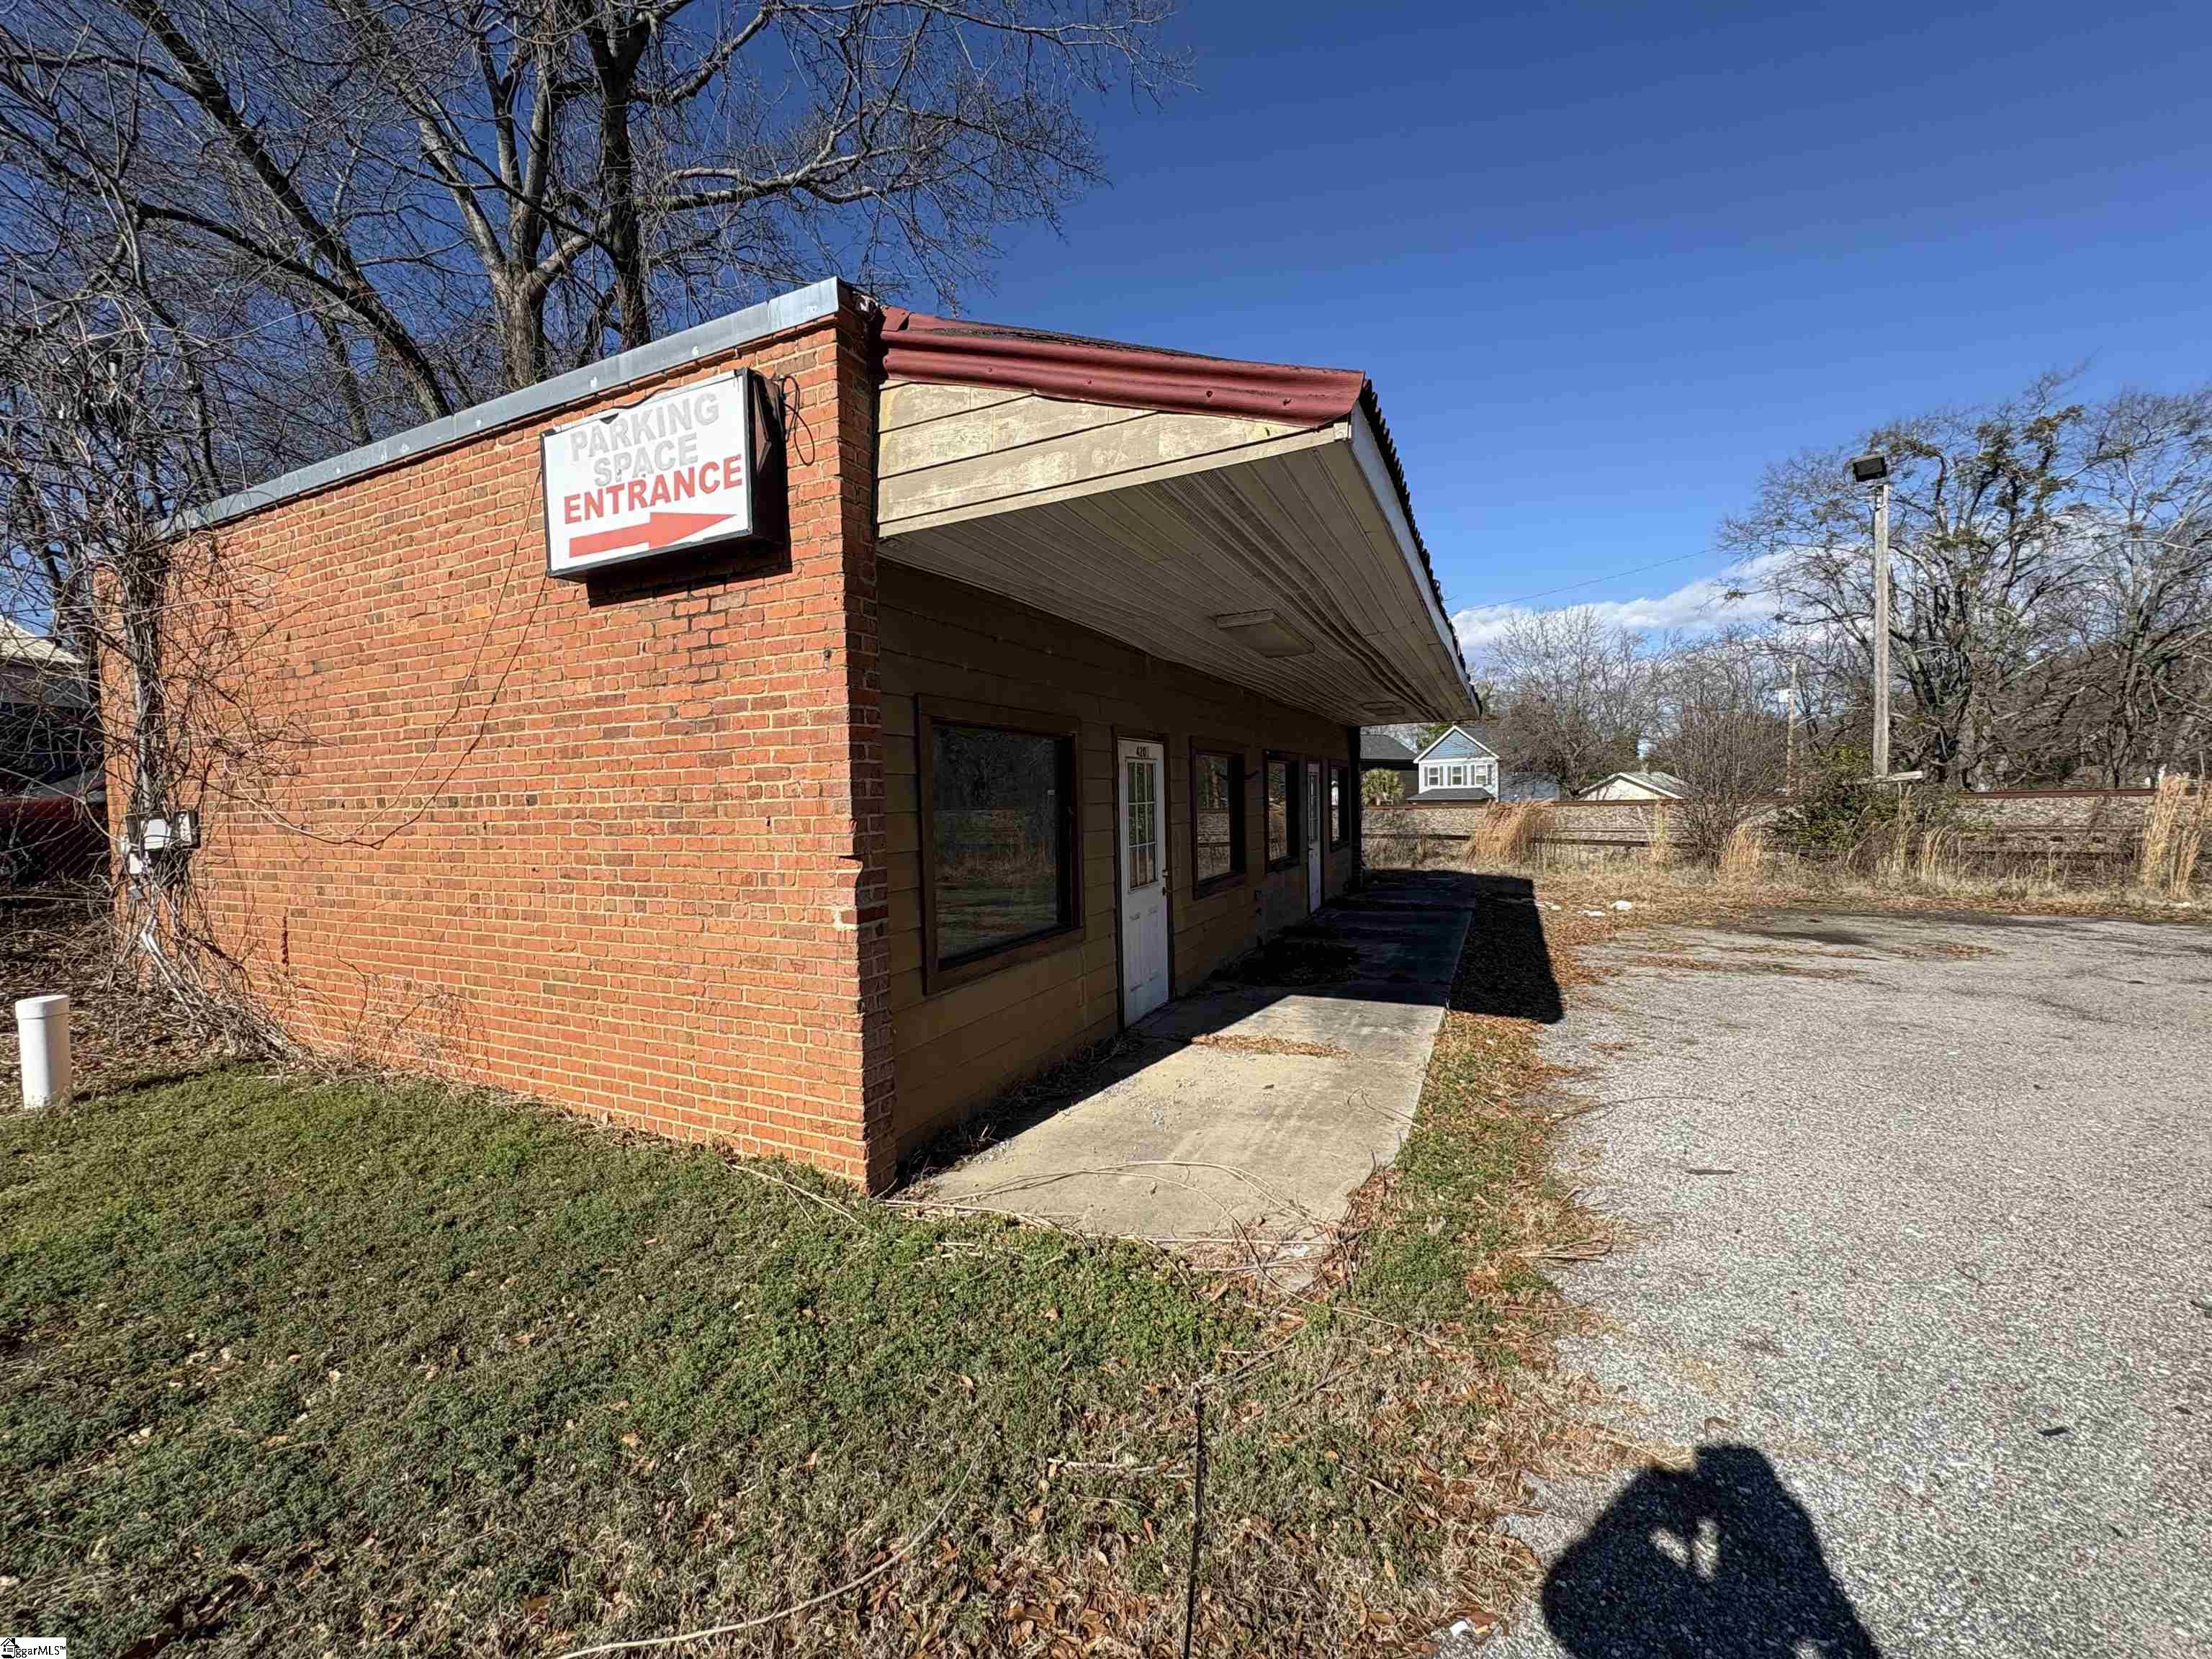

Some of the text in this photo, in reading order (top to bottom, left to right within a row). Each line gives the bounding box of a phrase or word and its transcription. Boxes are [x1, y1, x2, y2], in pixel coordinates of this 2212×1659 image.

[570, 392, 719, 462] PARKING
[593, 432, 698, 487] SPACE
[564, 454, 743, 524] ENTRANCE
